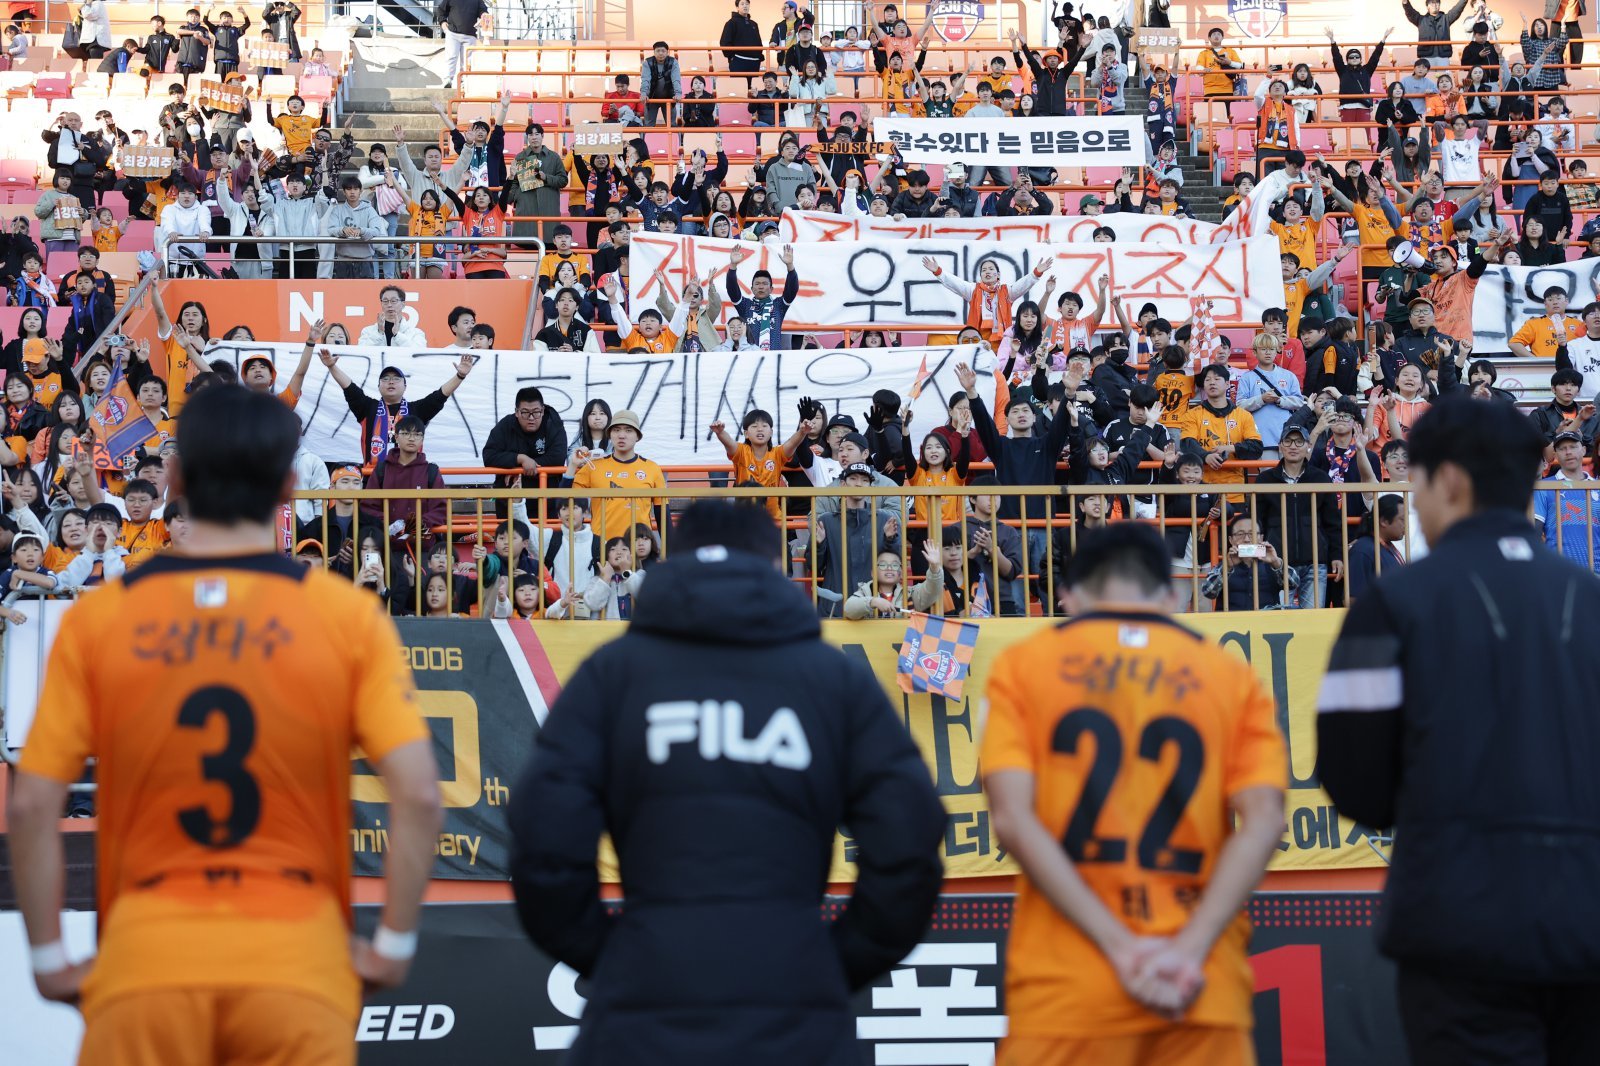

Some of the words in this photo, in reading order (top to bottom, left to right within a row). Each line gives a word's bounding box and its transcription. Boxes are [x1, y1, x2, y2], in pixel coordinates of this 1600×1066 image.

[1138, 35, 1178, 47] 최강제주
[202, 87, 241, 106] 최강제주
[575, 132, 622, 146] 최강제주
[819, 142, 849, 154] JEJU
[851, 142, 868, 154] SK
[869, 142, 884, 153] FC
[888, 129, 989, 155] 할수있다
[998, 131, 1021, 154] 는
[1030, 129, 1132, 154] 믿음으로
[124, 155, 172, 168] 최강제주
[1056, 245, 1250, 323] 자존심
[645, 700, 812, 770] FILA
[177, 684, 261, 850] 3
[1051, 707, 1206, 875] 22
